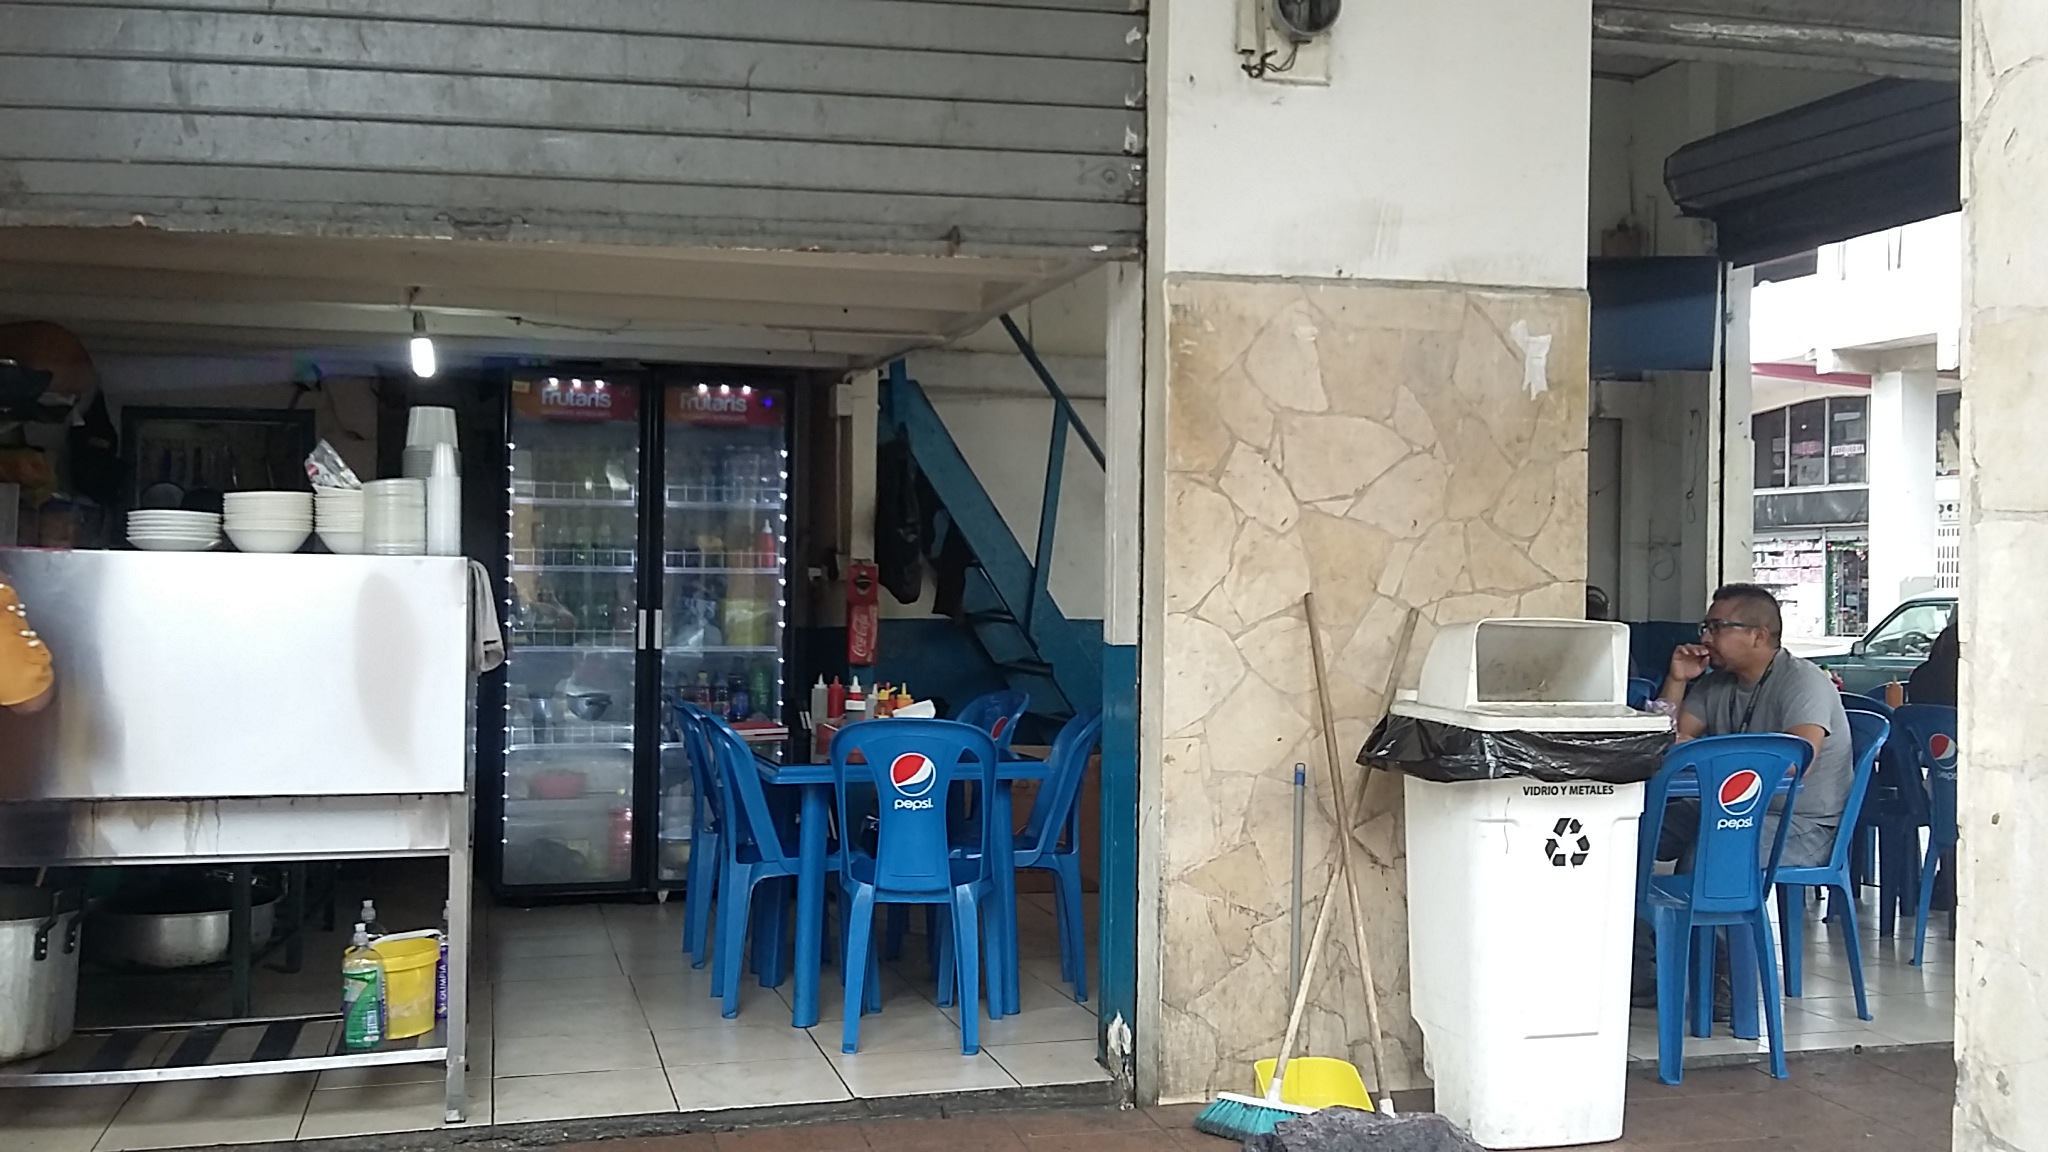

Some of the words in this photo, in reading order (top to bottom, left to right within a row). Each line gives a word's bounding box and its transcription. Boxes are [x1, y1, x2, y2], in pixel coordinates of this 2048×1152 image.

[1937, 771, 1957, 780] peps
[1522, 786, 1559, 796] VIDRIO
[1560, 786, 1568, 796] Y
[1569, 785, 1615, 795] METALES
[894, 797, 934, 811] pepsi
[1716, 816, 1754, 830] pepsi
